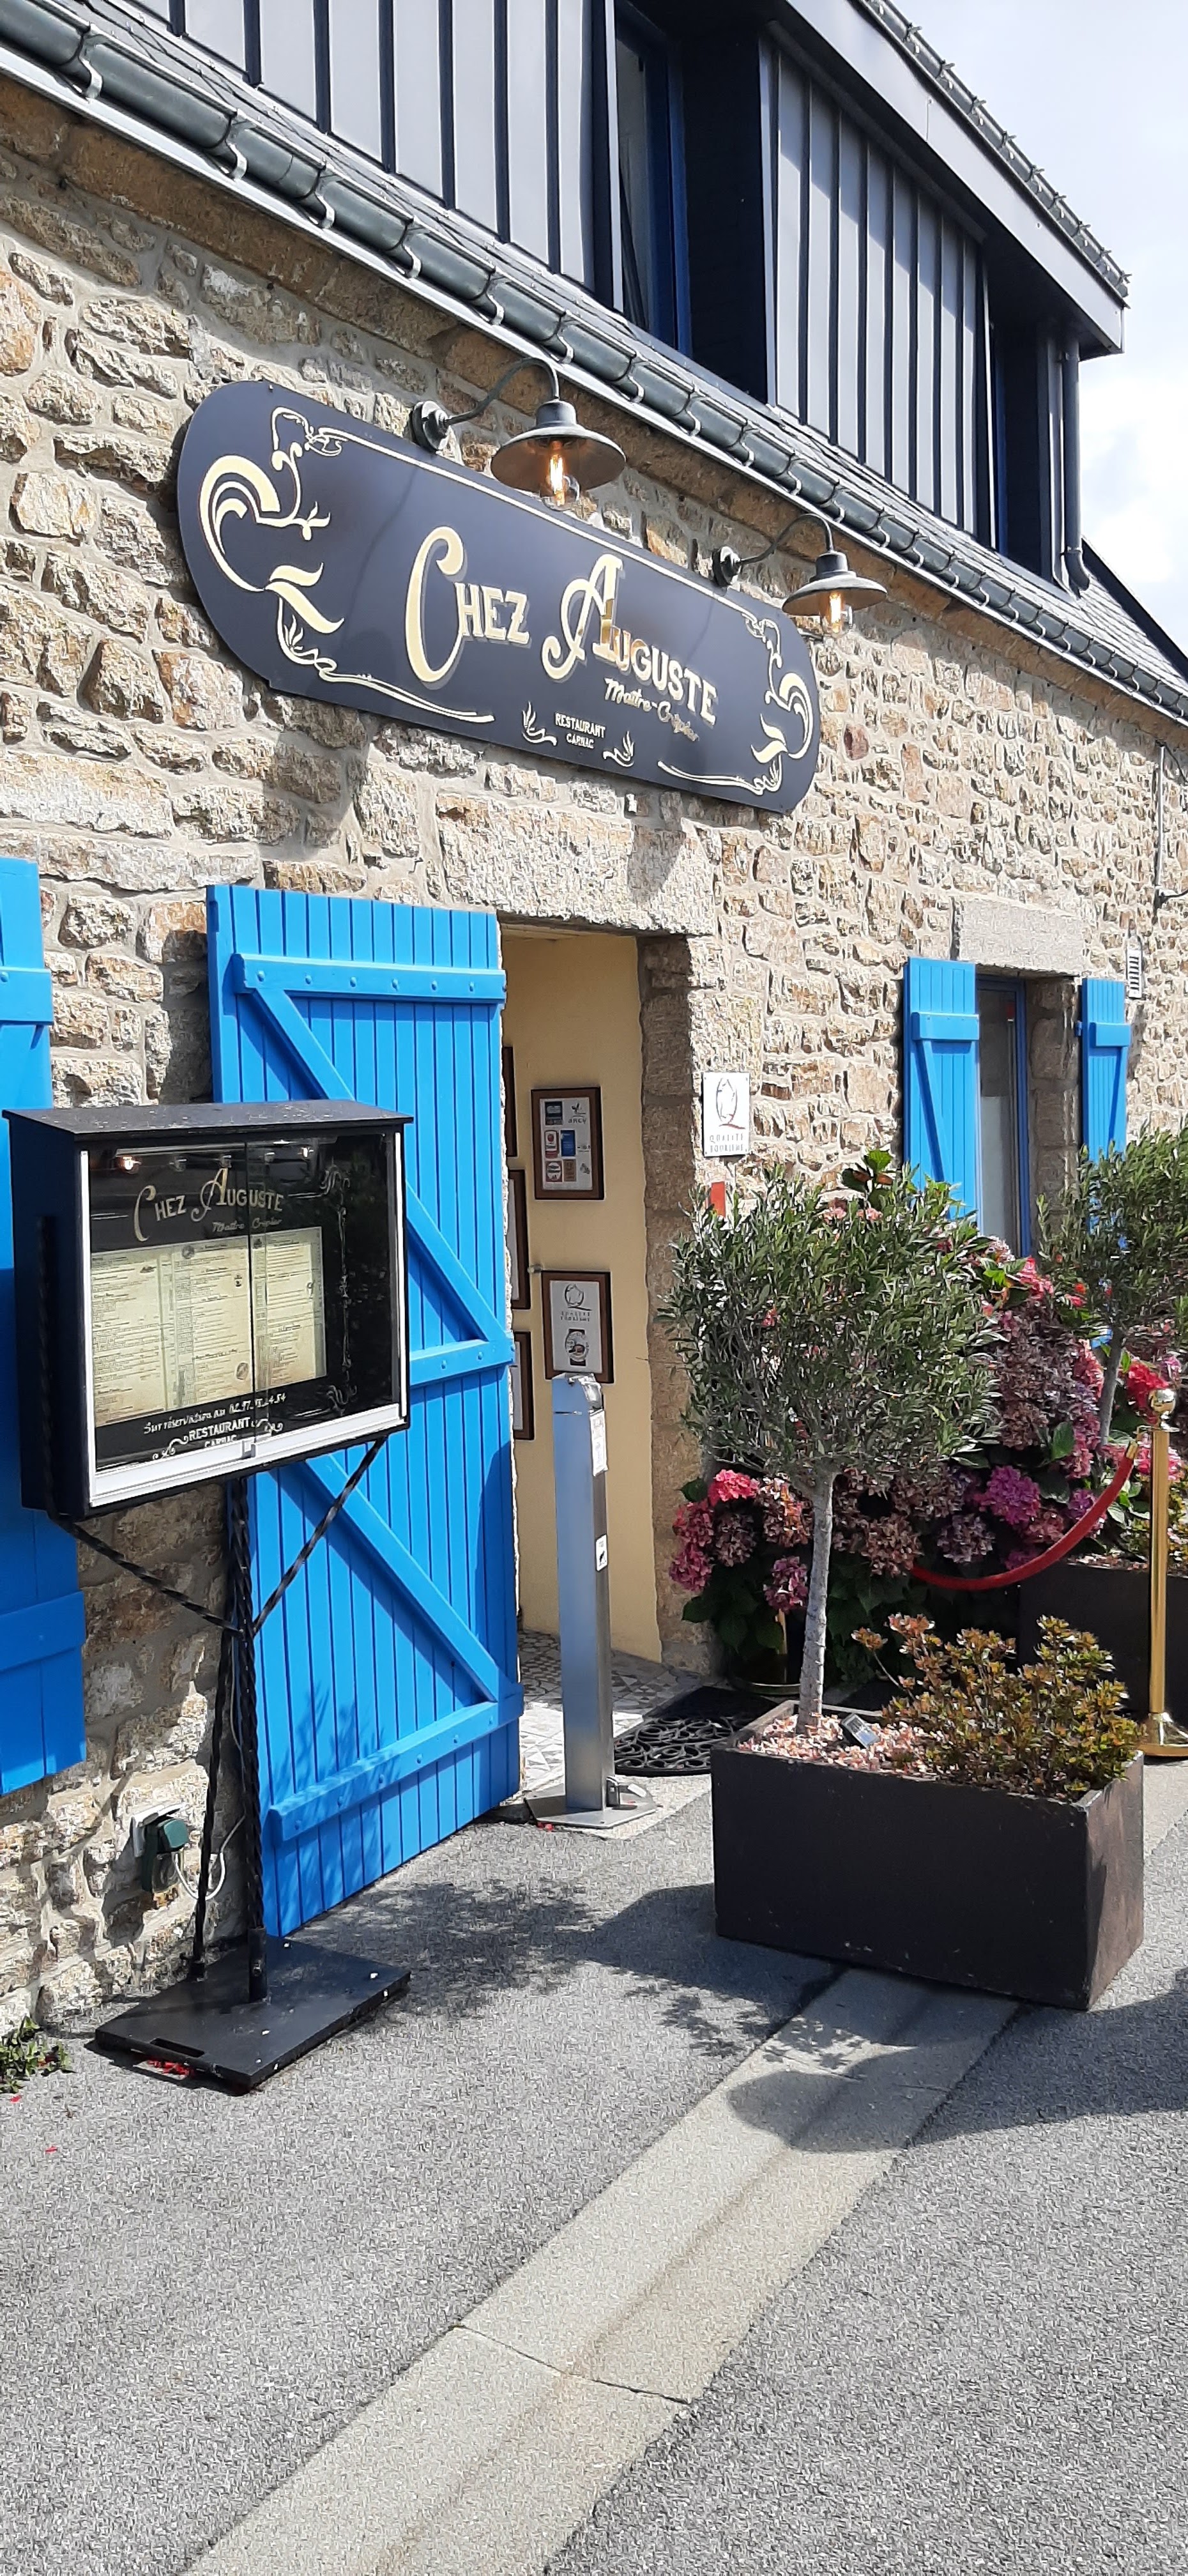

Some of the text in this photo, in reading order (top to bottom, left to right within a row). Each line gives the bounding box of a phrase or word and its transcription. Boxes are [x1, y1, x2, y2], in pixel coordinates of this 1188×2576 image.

[405, 526, 717, 726] CHEZ AUGUSTE
[555, 713, 605, 738] RESTAURANT
[134, 1167, 284, 1242] CHEZ AUGUSTE
[189, 1417, 250, 1441] RESTAURANT
